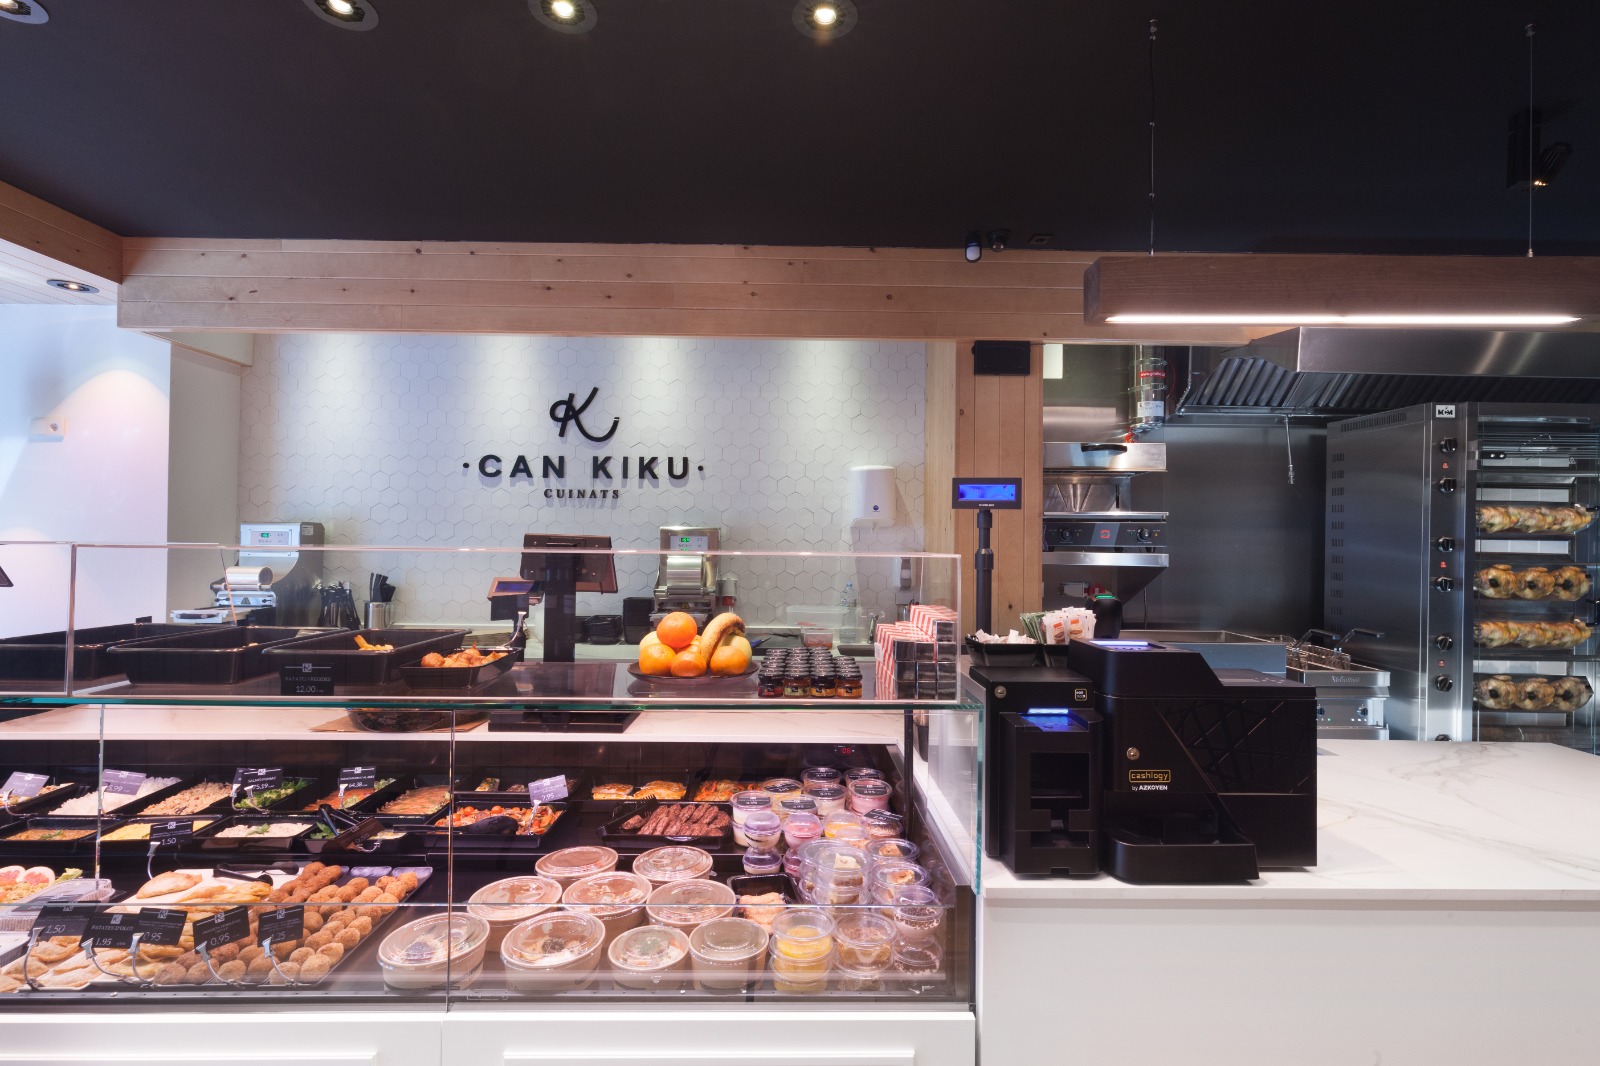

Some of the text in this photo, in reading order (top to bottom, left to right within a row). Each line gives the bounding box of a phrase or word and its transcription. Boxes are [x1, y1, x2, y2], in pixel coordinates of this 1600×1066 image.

[478, 454, 690, 481] CAN KIKU
[543, 488, 620, 500] CUINATS
[295, 685, 317, 693] 12.00
[1131, 771, 1169, 781] cashlogy
[161, 837, 177, 846] 1.50
[45, 924, 66, 934] 1.50
[95, 937, 113, 946] 1.95
[209, 932, 231, 947] 0.95
